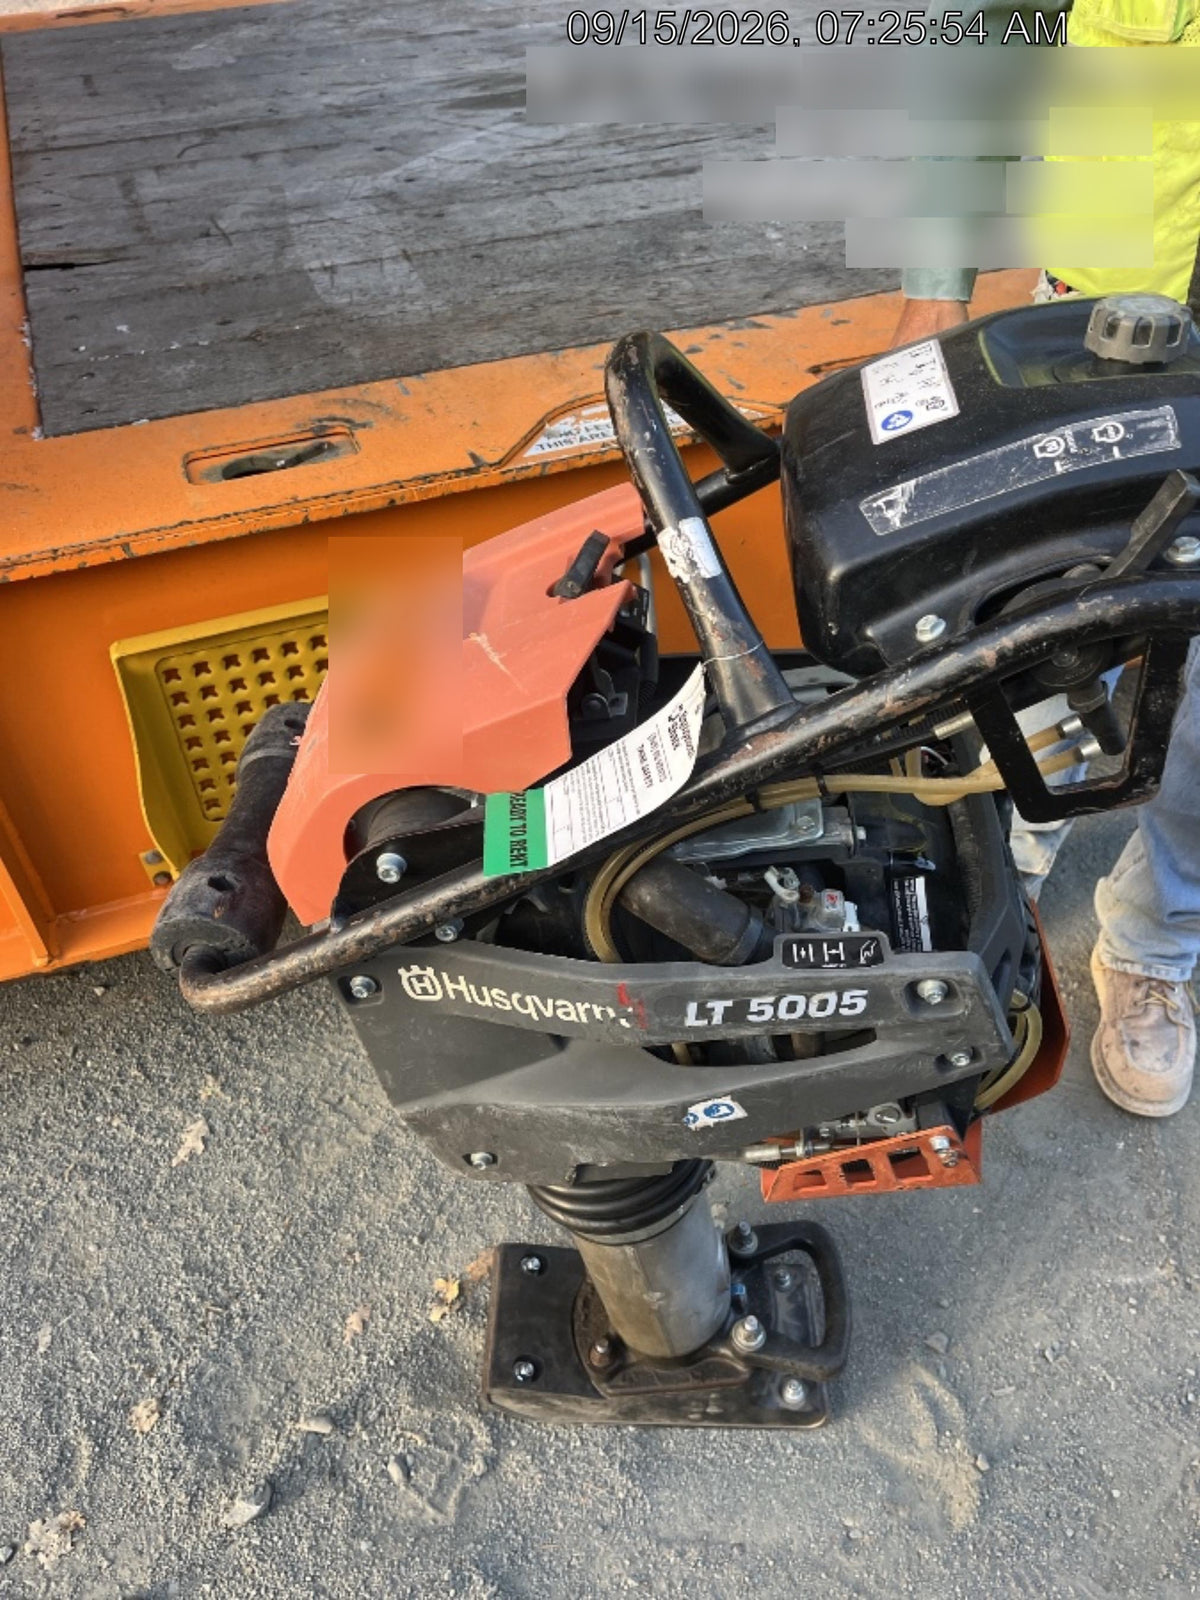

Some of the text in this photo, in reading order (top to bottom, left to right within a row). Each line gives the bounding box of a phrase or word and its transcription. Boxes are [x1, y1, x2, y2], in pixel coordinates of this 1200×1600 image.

[509, 823, 527, 837] TO
[509, 839, 528, 867] RENT
[684, 999, 733, 1027] LT
